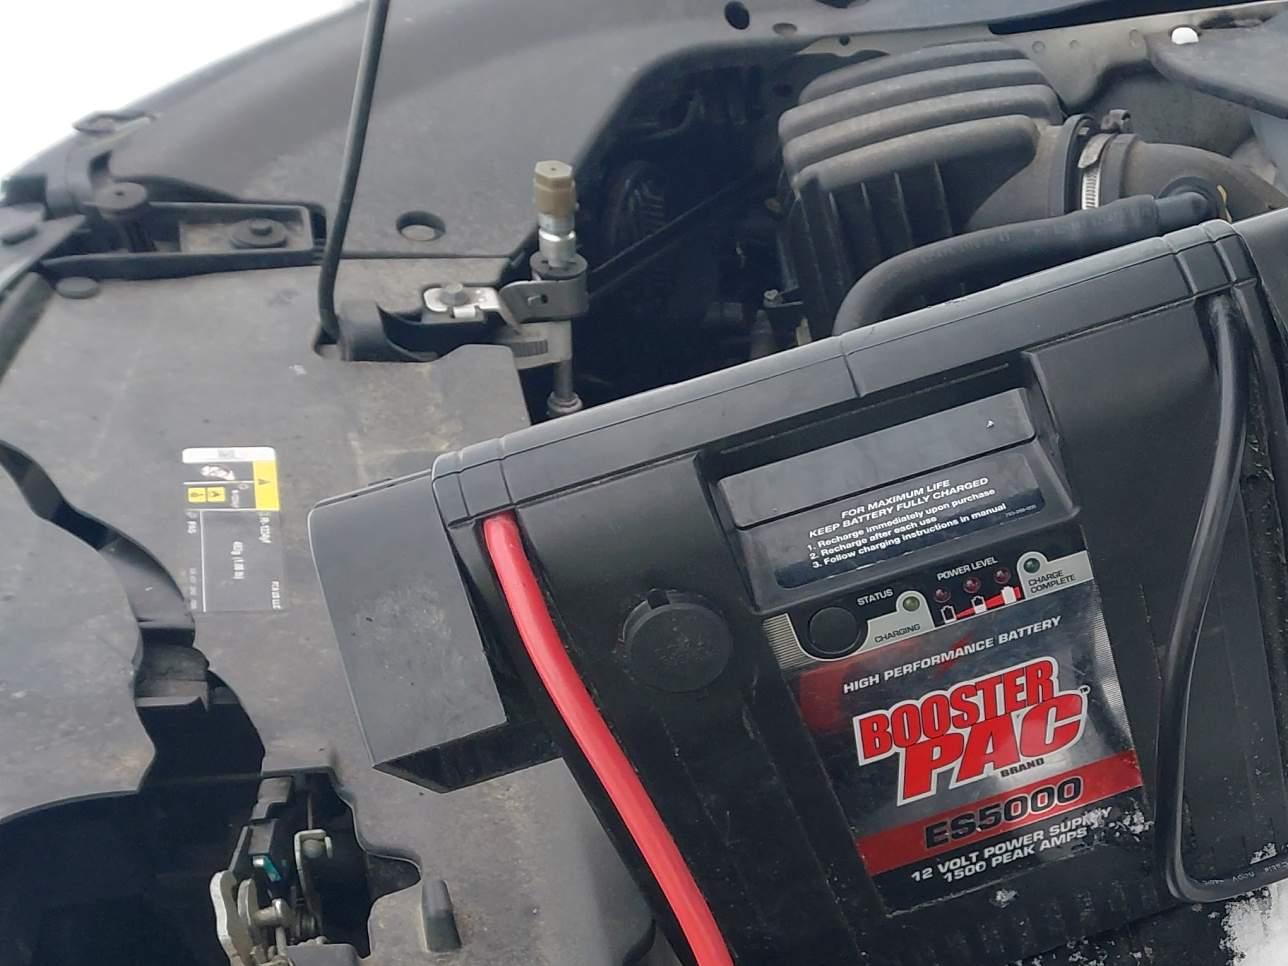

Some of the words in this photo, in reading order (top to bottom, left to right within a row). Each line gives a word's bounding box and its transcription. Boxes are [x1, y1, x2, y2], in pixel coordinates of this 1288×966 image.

[807, 544, 817, 552] 1.
[817, 529, 864, 549] Recharge
[866, 511, 924, 534] immediately
[925, 503, 951, 516] upon
[951, 488, 996, 509] purchase
[809, 523, 840, 538] KEEP
[843, 506, 894, 528] BATTERY
[896, 496, 930, 512] FULLY
[929, 477, 989, 500] CHARGED
[841, 505, 866, 519] FOR
[867, 487, 924, 511] MAXIMUM
[926, 479, 951, 493] LIFE
[809, 552, 820, 560] 2.
[820, 538, 868, 557] Recharge
[869, 528, 892, 541] after
[893, 522, 918, 535] each
[919, 516, 937, 527] use
[812, 561, 823, 569] 3.
[824, 549, 857, 565] Follow
[858, 537, 902, 555] charging
[901, 518, 959, 542] instructions
[960, 514, 970, 523] in
[971, 502, 1007, 519] manual
[936, 565, 971, 581] POWER
[971, 556, 999, 572] LEVEL
[1027, 569, 1064, 585] CHARGE
[1030, 574, 1076, 594] COMPLETE
[857, 588, 894, 606] STATUS
[843, 673, 880, 694] HIGH
[884, 637, 994, 681] PERFORMANCE
[998, 616, 1061, 644] BATTERY
[874, 623, 921, 643] CHARGING
[855, 657, 1057, 764] BOOSTER
[899, 692, 1087, 803] PAC
[1000, 757, 1045, 777] BRAND
[924, 776, 1083, 849] ES5000
[911, 869, 934, 882] 12
[937, 850, 980, 873] VOLT
[983, 830, 1044, 859] POWER
[1049, 807, 1112, 836] SUPY
[943, 862, 987, 883] 1500
[991, 847, 1035, 868] PEAK
[1039, 827, 1088, 850] AMPS
